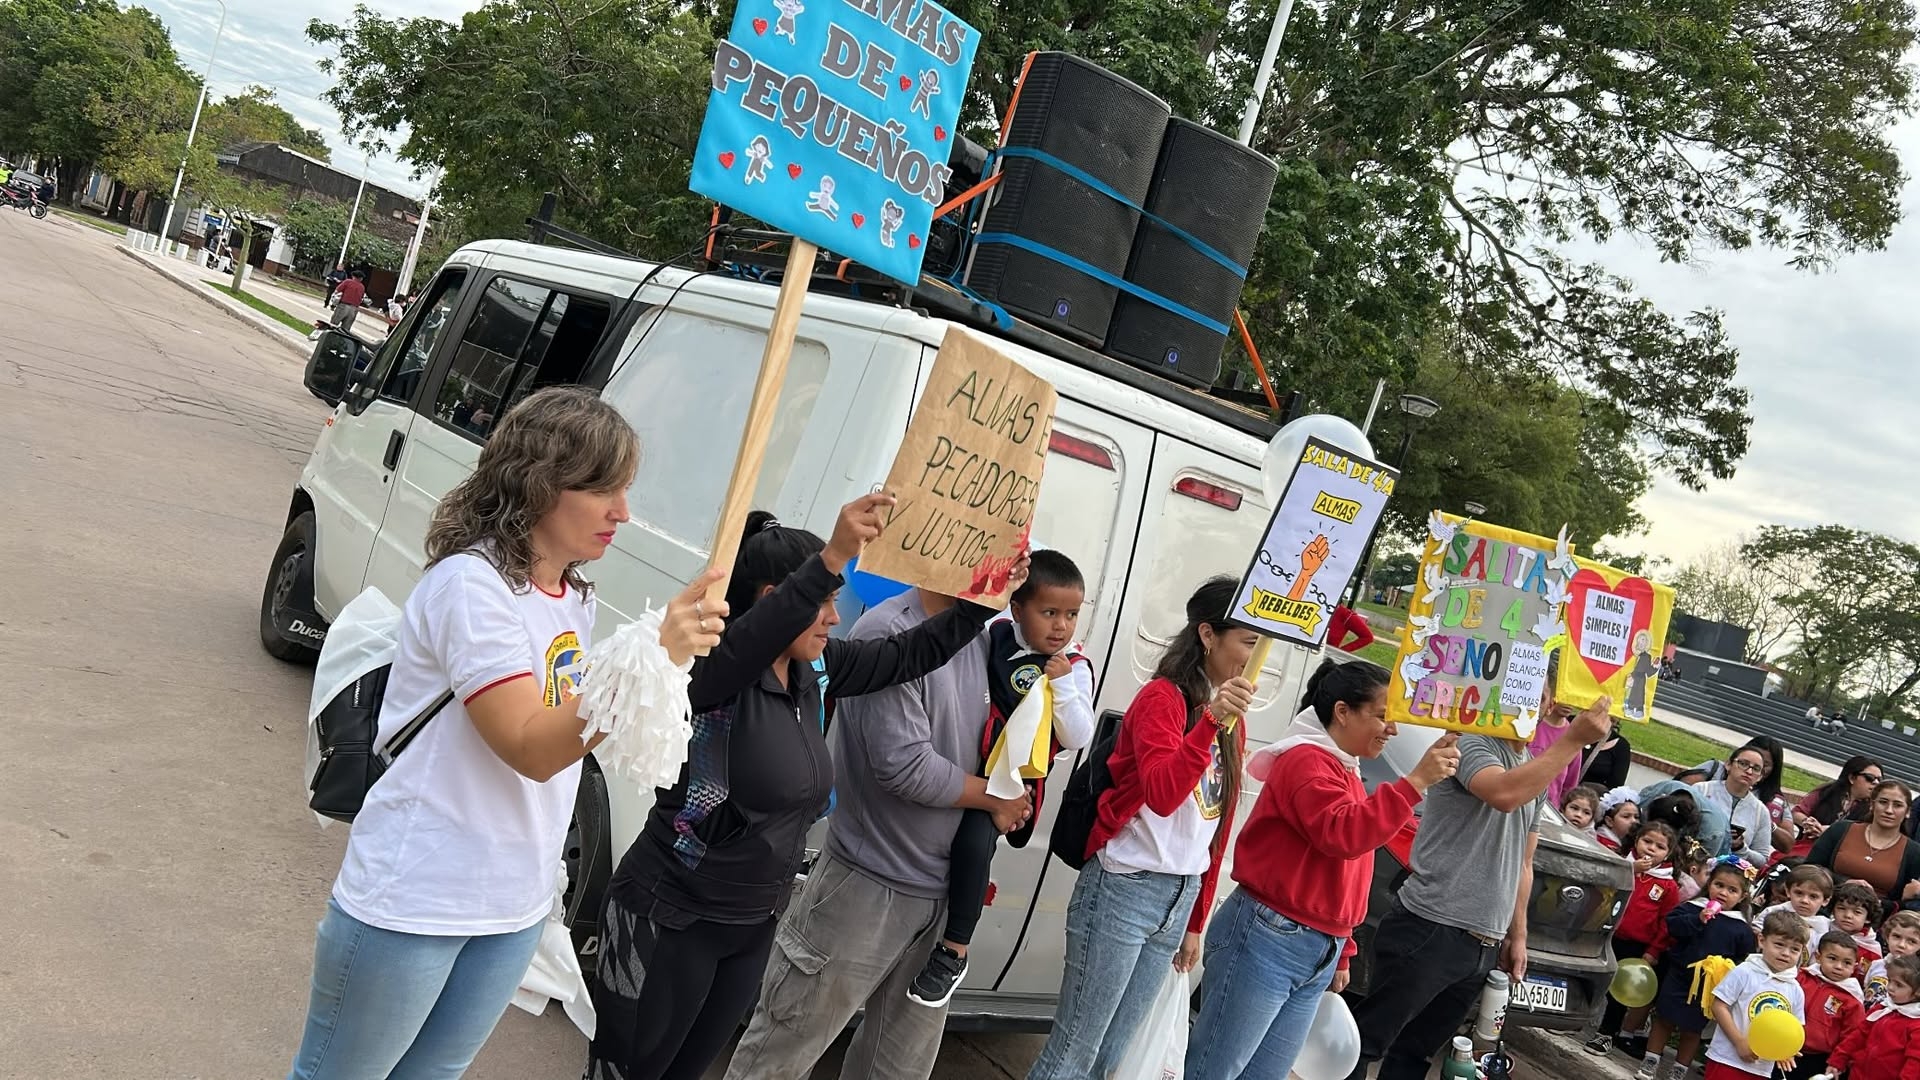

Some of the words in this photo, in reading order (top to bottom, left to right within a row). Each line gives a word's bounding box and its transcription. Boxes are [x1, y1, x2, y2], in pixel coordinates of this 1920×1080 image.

[843, 0, 966, 65] MAS
[820, 22, 896, 100] DE
[711, 39, 953, 207] PEQUEÑOS
[946, 370, 1040, 445] ALMAS
[918, 435, 1040, 528] PECADORES
[1302, 444, 1348, 474] SALA
[1349, 461, 1374, 484] DE
[1372, 470, 1397, 497] 4A
[1316, 498, 1357, 522] ALMAS
[901, 506, 997, 568] JUSTOS
[1444, 533, 1548, 594] SALITA
[1257, 593, 1315, 621] REBELDES
[1442, 588, 1487, 629] DE
[1500, 598, 1525, 640] 4
[1595, 594, 1626, 616] ALMAS
[1585, 616, 1621, 639] SIMPLES
[1619, 624, 1630, 640] Y
[1508, 662, 1546, 680] BLANCAS
[1510, 646, 1542, 662] ALMAS
[1589, 643, 1618, 662] PURAS
[1409, 677, 1503, 728] ERICA
[1501, 692, 1541, 709] PALOMAS
[1505, 678, 1533, 692] COMO
[1529, 984, 1549, 1006] 658
